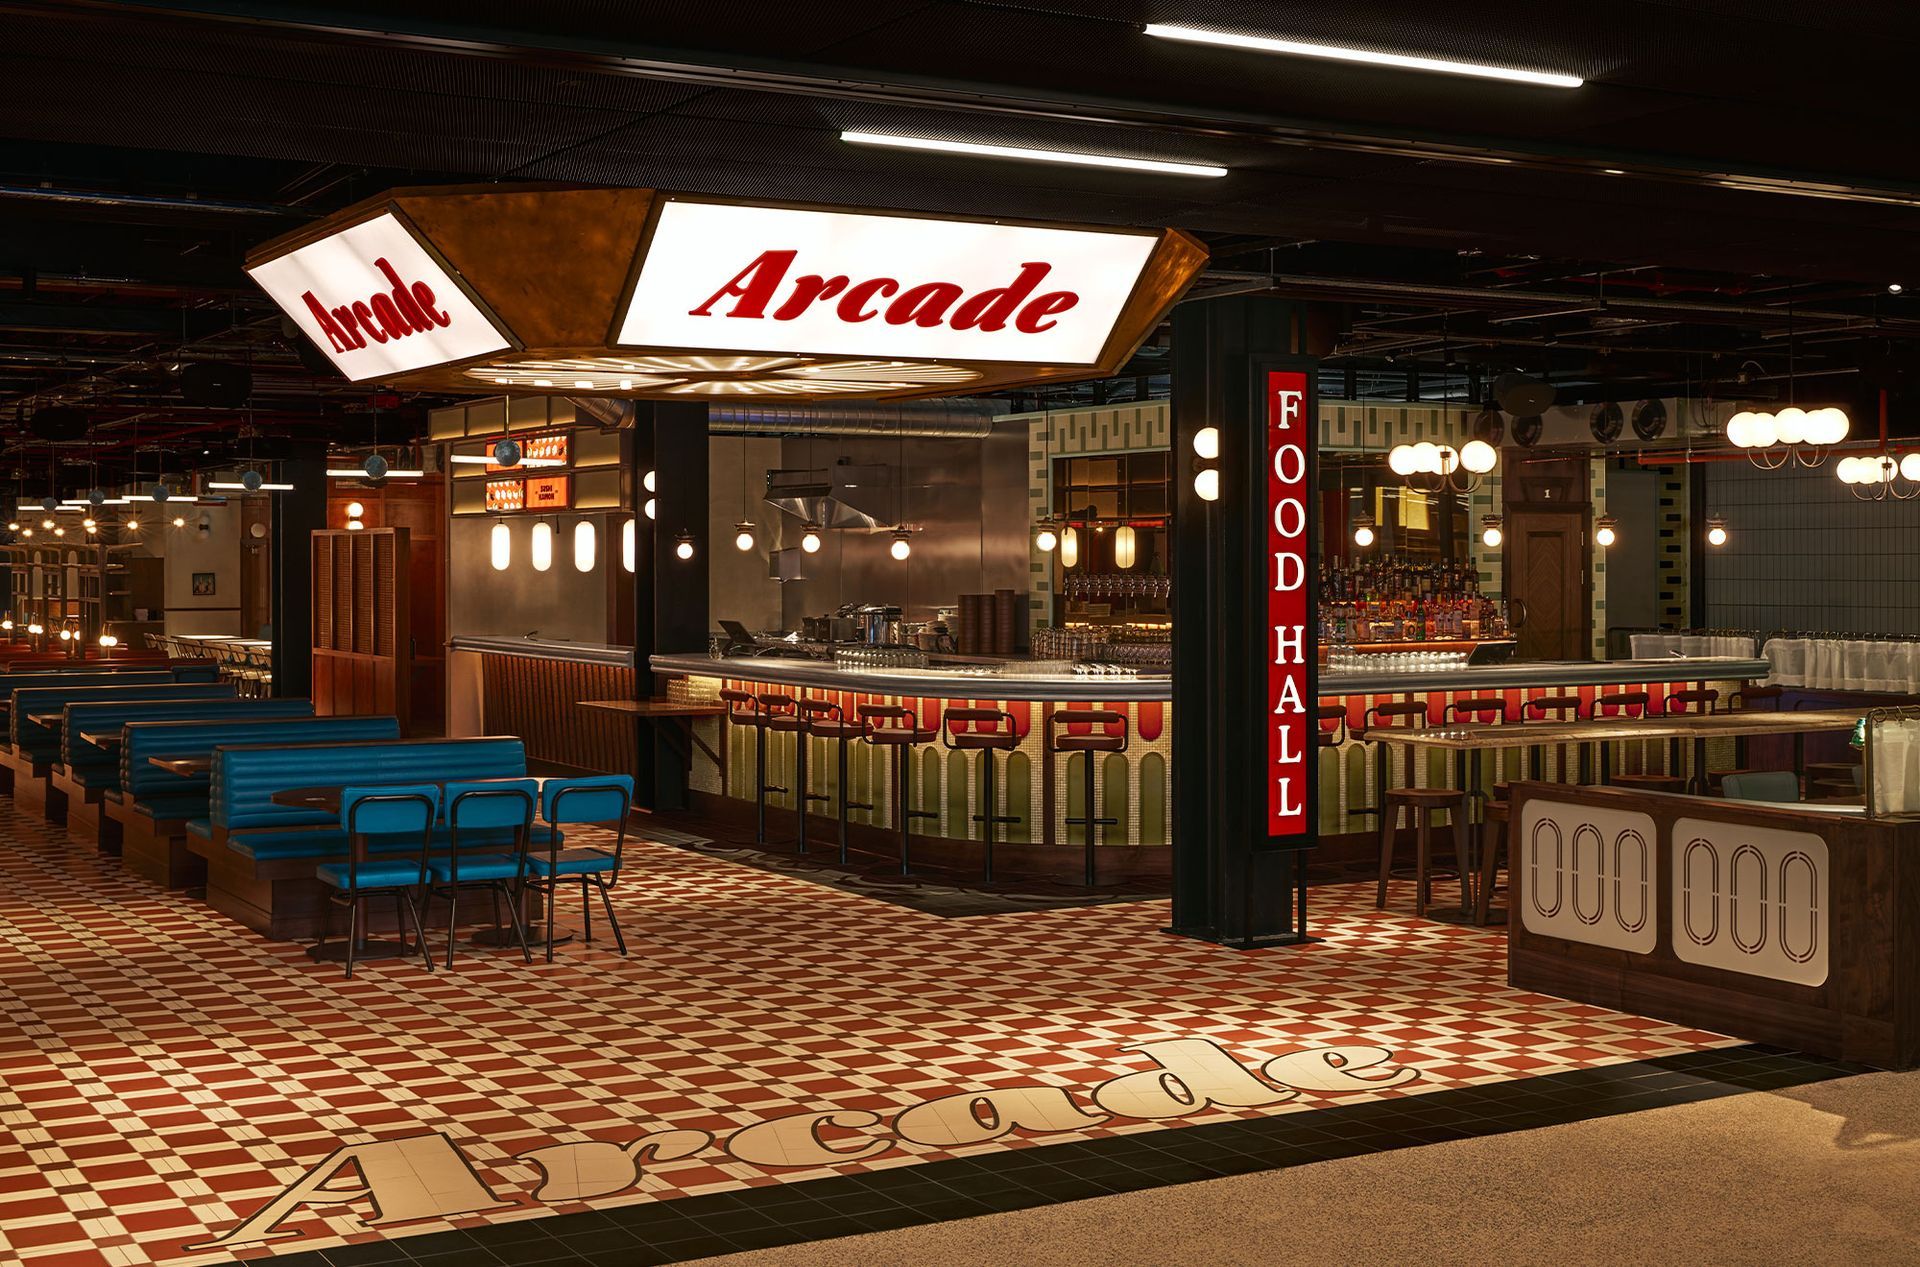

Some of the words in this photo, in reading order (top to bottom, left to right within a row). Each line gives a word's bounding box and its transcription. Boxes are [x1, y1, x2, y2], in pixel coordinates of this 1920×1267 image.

[303, 257, 451, 352] Arcade
[689, 250, 1079, 335] Arcade
[1274, 390, 1307, 592] FOOD
[1544, 489, 1551, 499] 1
[1273, 624, 1307, 818] HALL
[183, 1038, 1422, 1251] Arcade
